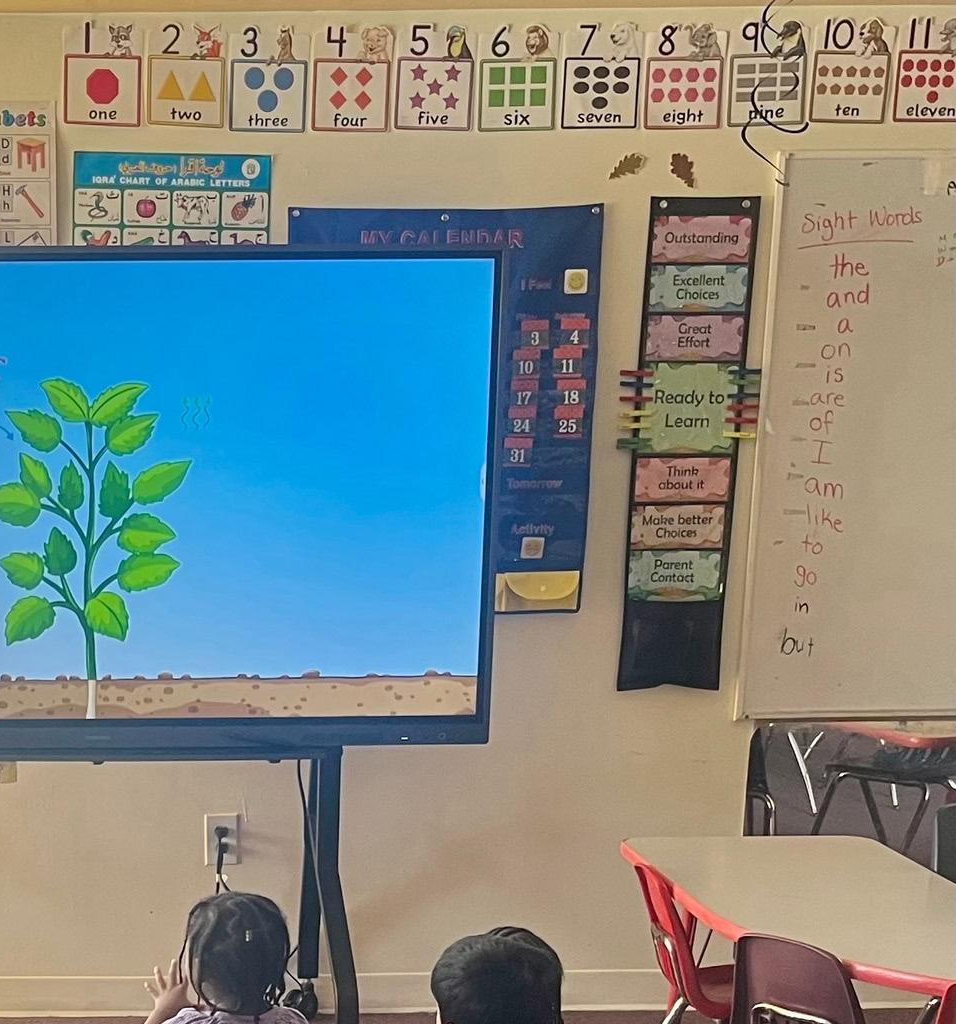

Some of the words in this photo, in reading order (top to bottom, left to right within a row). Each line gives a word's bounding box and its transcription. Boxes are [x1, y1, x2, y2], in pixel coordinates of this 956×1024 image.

[84, 21, 91, 54] 1
[162, 24, 181, 55] 2
[410, 25, 434, 56] 5
[579, 25, 598, 56] 7
[658, 25, 675, 56] 8
[742, 21, 759, 54] 9
[824, 18, 854, 50] 10
[909, 18, 931, 49] 11
[241, 27, 258, 58] 3
[327, 26, 346, 58] 4
[491, 26, 510, 57] 6
[89, 108, 117, 120] one
[170, 108, 202, 121] two
[418, 110, 448, 126] five
[504, 110, 531, 126] six
[577, 112, 622, 124] seven
[663, 110, 704, 124] eight
[748, 105, 785, 120] nine
[835, 104, 860, 117] ten
[906, 103, 956, 118] eleven
[248, 113, 289, 127] three
[333, 112, 367, 128] four
[1, 138, 10, 149] D
[1, 154, 9, 164] d
[119, 177, 150, 185] CHART
[155, 178, 168, 186] OF
[171, 178, 205, 187] ARABIC
[210, 179, 250, 187] LETTERS
[2, 185, 11, 196] H
[801, 210, 859, 241] Sight
[869, 206, 924, 226] Words
[5, 232, 11, 243] L
[360, 230, 393, 244] MY
[400, 229, 524, 249] CALENDAR
[664, 231, 739, 246] Outstanding
[829, 253, 869, 279] the
[673, 274, 725, 286] Excellent
[676, 288, 719, 300] Choices
[827, 283, 870, 308] and
[678, 323, 711, 334] Great
[837, 317, 853, 334] a
[531, 331, 540, 345] 3
[570, 330, 580, 345] 4
[677, 336, 710, 348] Effort
[821, 343, 851, 360] on
[519, 360, 533, 374] 10
[561, 359, 574, 373] 11
[826, 366, 844, 383] is
[516, 391, 531, 405] 17
[563, 391, 579, 404] 18
[654, 390, 704, 408] Ready
[709, 391, 725, 404] to
[810, 389, 844, 407] are
[513, 419, 530, 432] 24
[559, 420, 576, 433] 25
[664, 414, 709, 428] Learn
[809, 410, 834, 434] of
[510, 449, 525, 463] 31
[810, 440, 833, 465] I
[666, 466, 699, 477] Think
[507, 478, 563, 489] Tomorrow
[658, 478, 693, 490] about
[697, 478, 704, 490] it
[804, 477, 843, 499] am
[642, 514, 674, 526] Make
[678, 513, 713, 525] better
[806, 504, 843, 533] like
[511, 524, 555, 536] Activity
[656, 527, 697, 538] Choices
[801, 534, 823, 555] to
[654, 559, 694, 570] Parent
[650, 571, 694, 583] Contact
[794, 565, 817, 587] go
[795, 596, 809, 614] in
[780, 628, 814, 656] but
